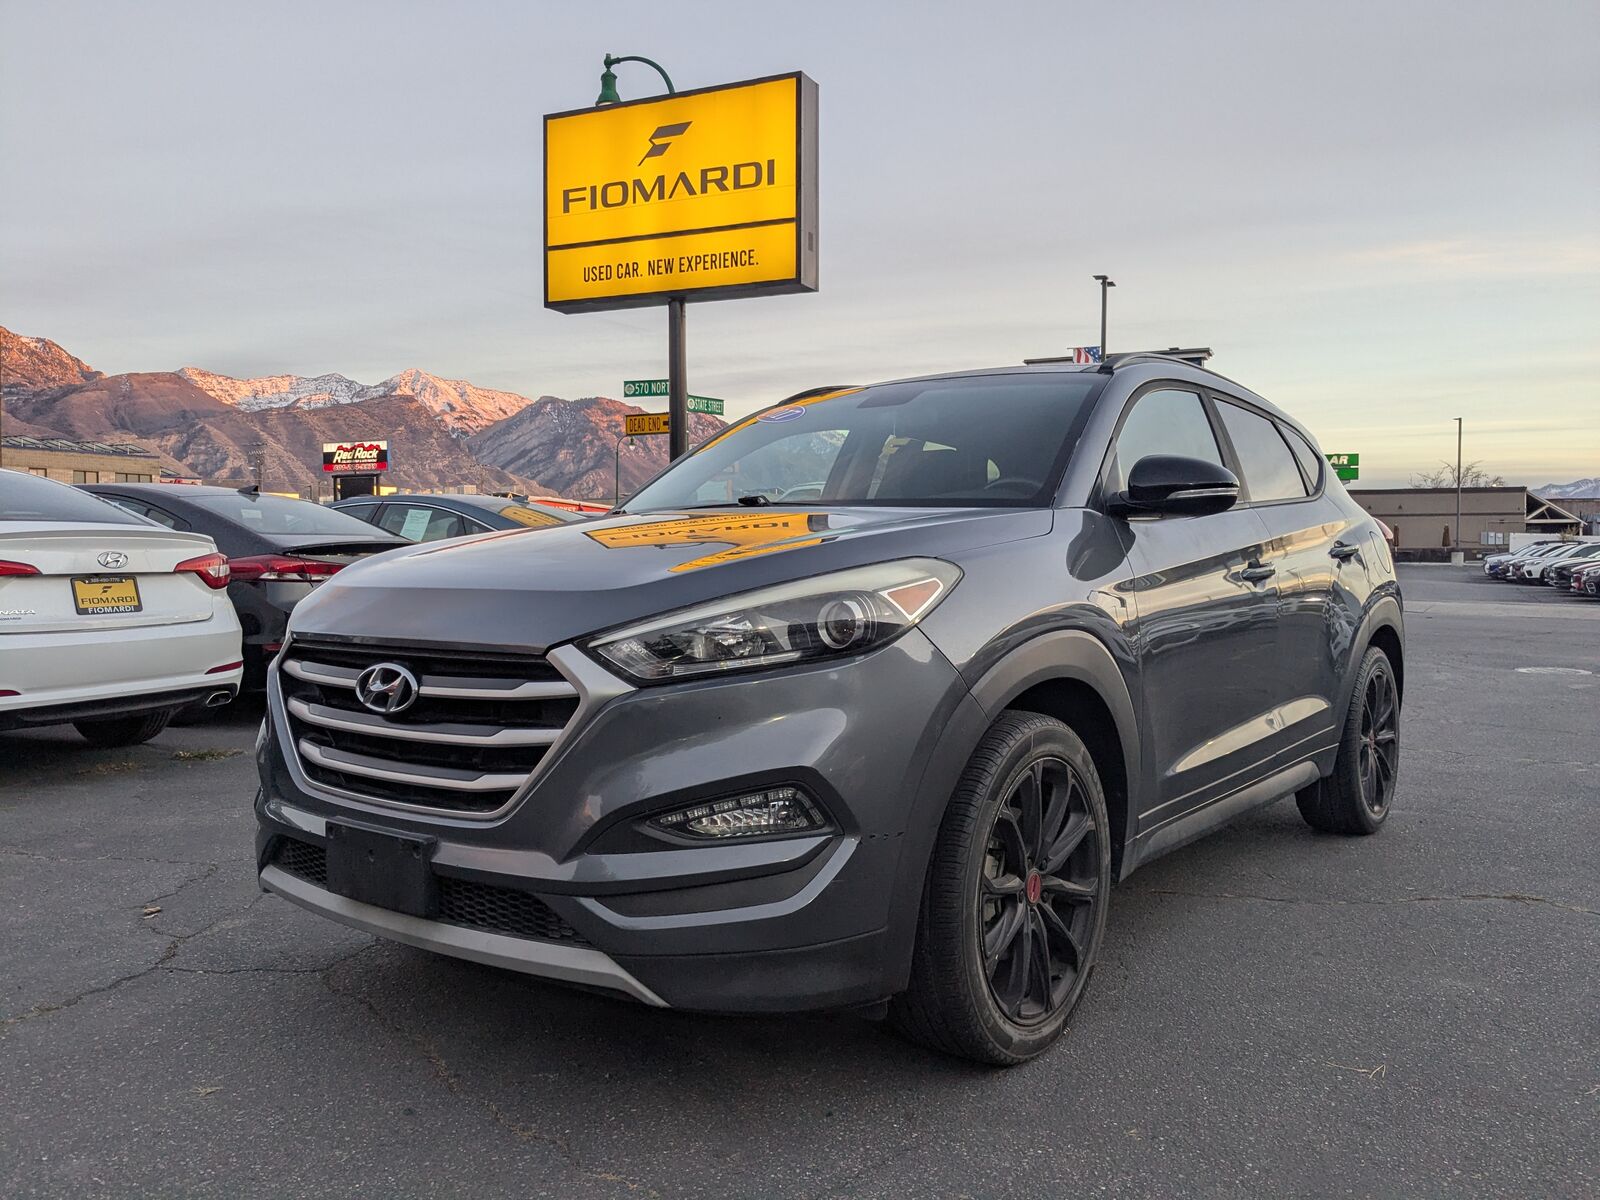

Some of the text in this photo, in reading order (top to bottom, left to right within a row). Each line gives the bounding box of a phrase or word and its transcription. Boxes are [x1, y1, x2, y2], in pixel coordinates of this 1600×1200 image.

[562, 159, 775, 214] FIOMARDI
[583, 248, 759, 283] USED CAR. NEW EXPERIENCE.
[635, 383, 649, 395] 570
[694, 398, 723, 413] STATE STREET
[629, 417, 661, 432] DEAD END
[333, 447, 379, 463] Red Rock
[81, 596, 136, 605] FIOMARDI
[88, 606, 135, 614] FIOMARDI
